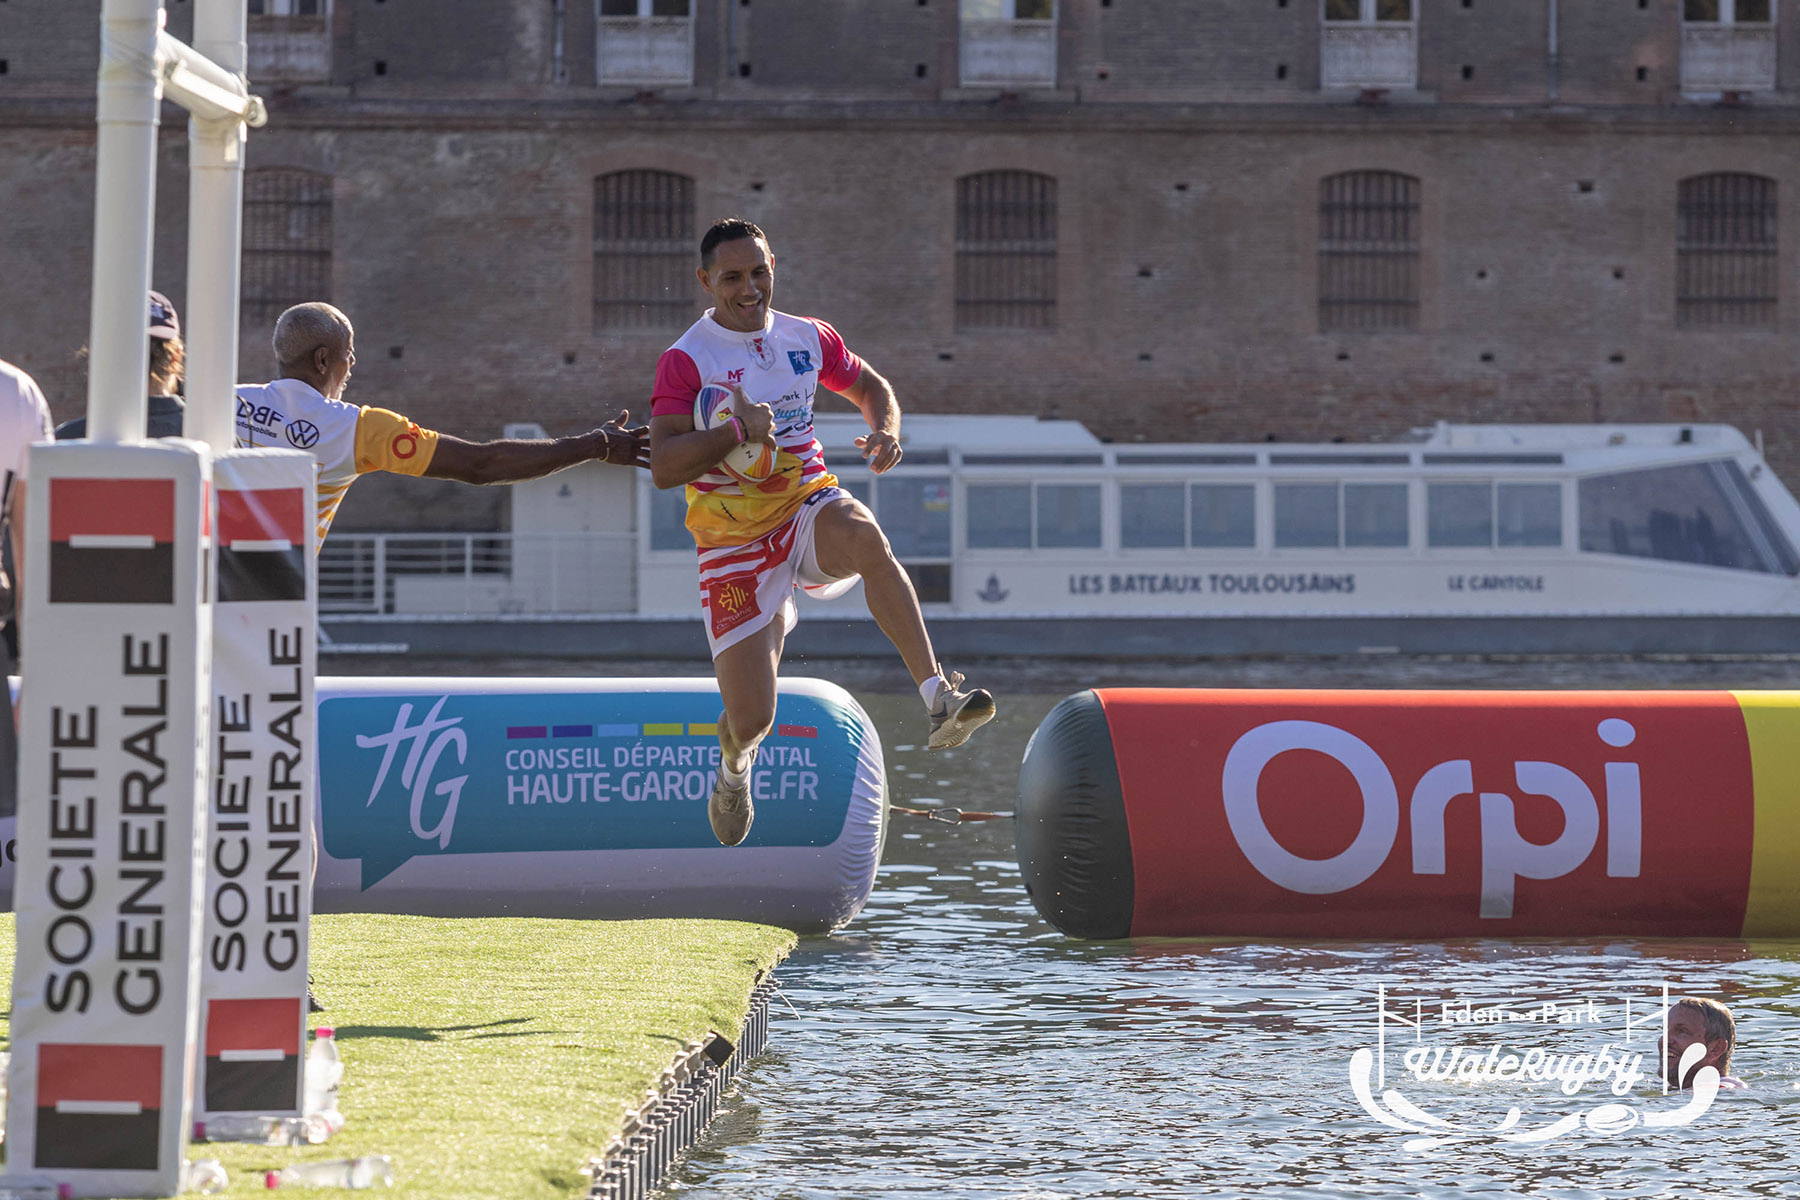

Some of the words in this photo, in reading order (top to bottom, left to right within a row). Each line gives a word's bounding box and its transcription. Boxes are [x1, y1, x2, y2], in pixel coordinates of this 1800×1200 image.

[727, 368, 745, 382] MF
[236, 401, 284, 427] DBF
[236, 420, 278, 438] utomobiles
[1069, 573, 1103, 594] LES
[1109, 573, 1202, 594] BATEAUX
[1208, 573, 1355, 594] TOULOUSAINS
[1448, 575, 1464, 592] LE
[505, 746, 607, 771] CONSEIL
[613, 740, 818, 768] DÉPARTENTAL
[264, 626, 303, 972] GENERALE
[507, 770, 818, 805] HAUTE-GARONE.FR
[113, 633, 170, 1016] GENERALE
[210, 692, 253, 973] SOCIETE
[1222, 718, 1642, 919] Orpi
[45, 705, 98, 1016] SOCIETE
